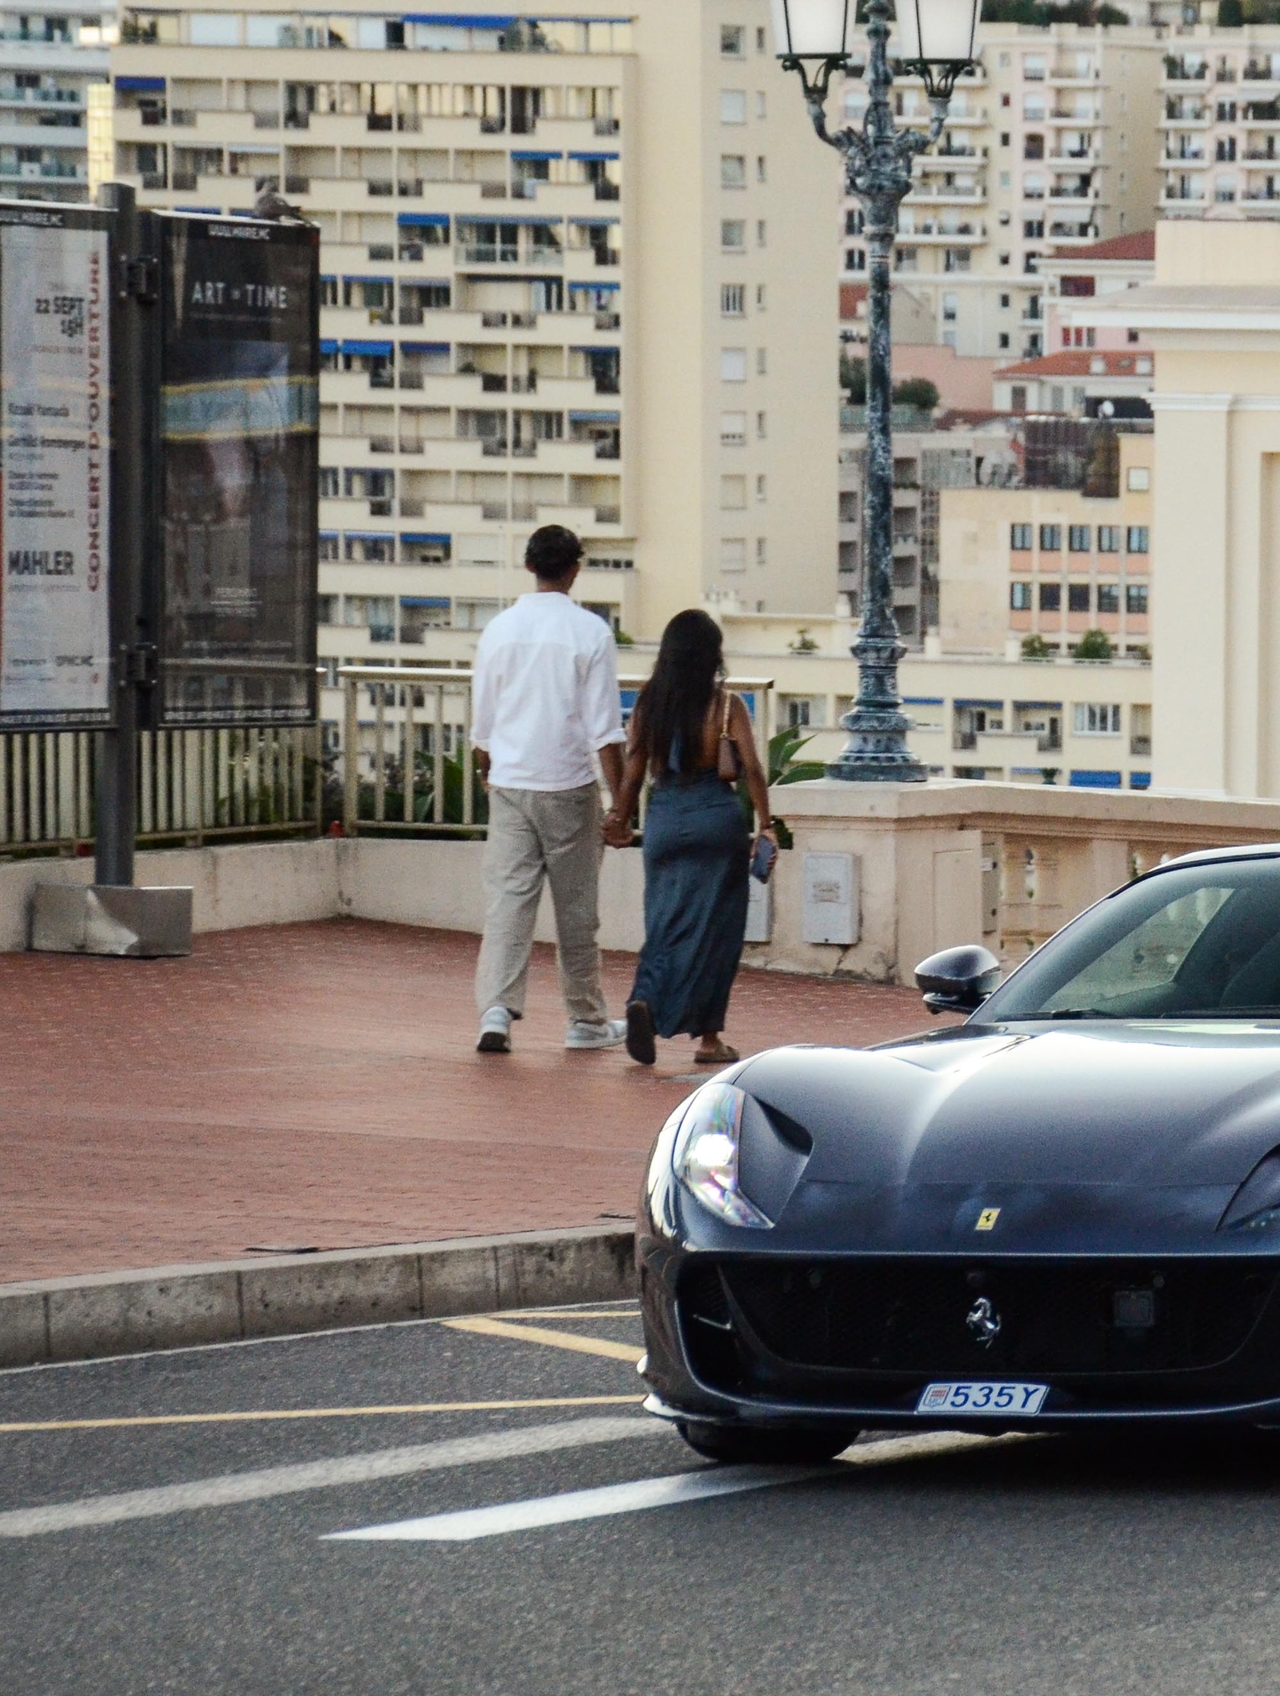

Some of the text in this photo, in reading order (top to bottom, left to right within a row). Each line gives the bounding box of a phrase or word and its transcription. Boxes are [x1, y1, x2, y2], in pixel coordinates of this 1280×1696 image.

[191, 281, 225, 305] ART
[245, 284, 288, 309] TIME
[87, 457, 100, 592] CONCERT
[8, 550, 74, 576] MAHLER
[950, 1385, 1040, 1409] 535Y
